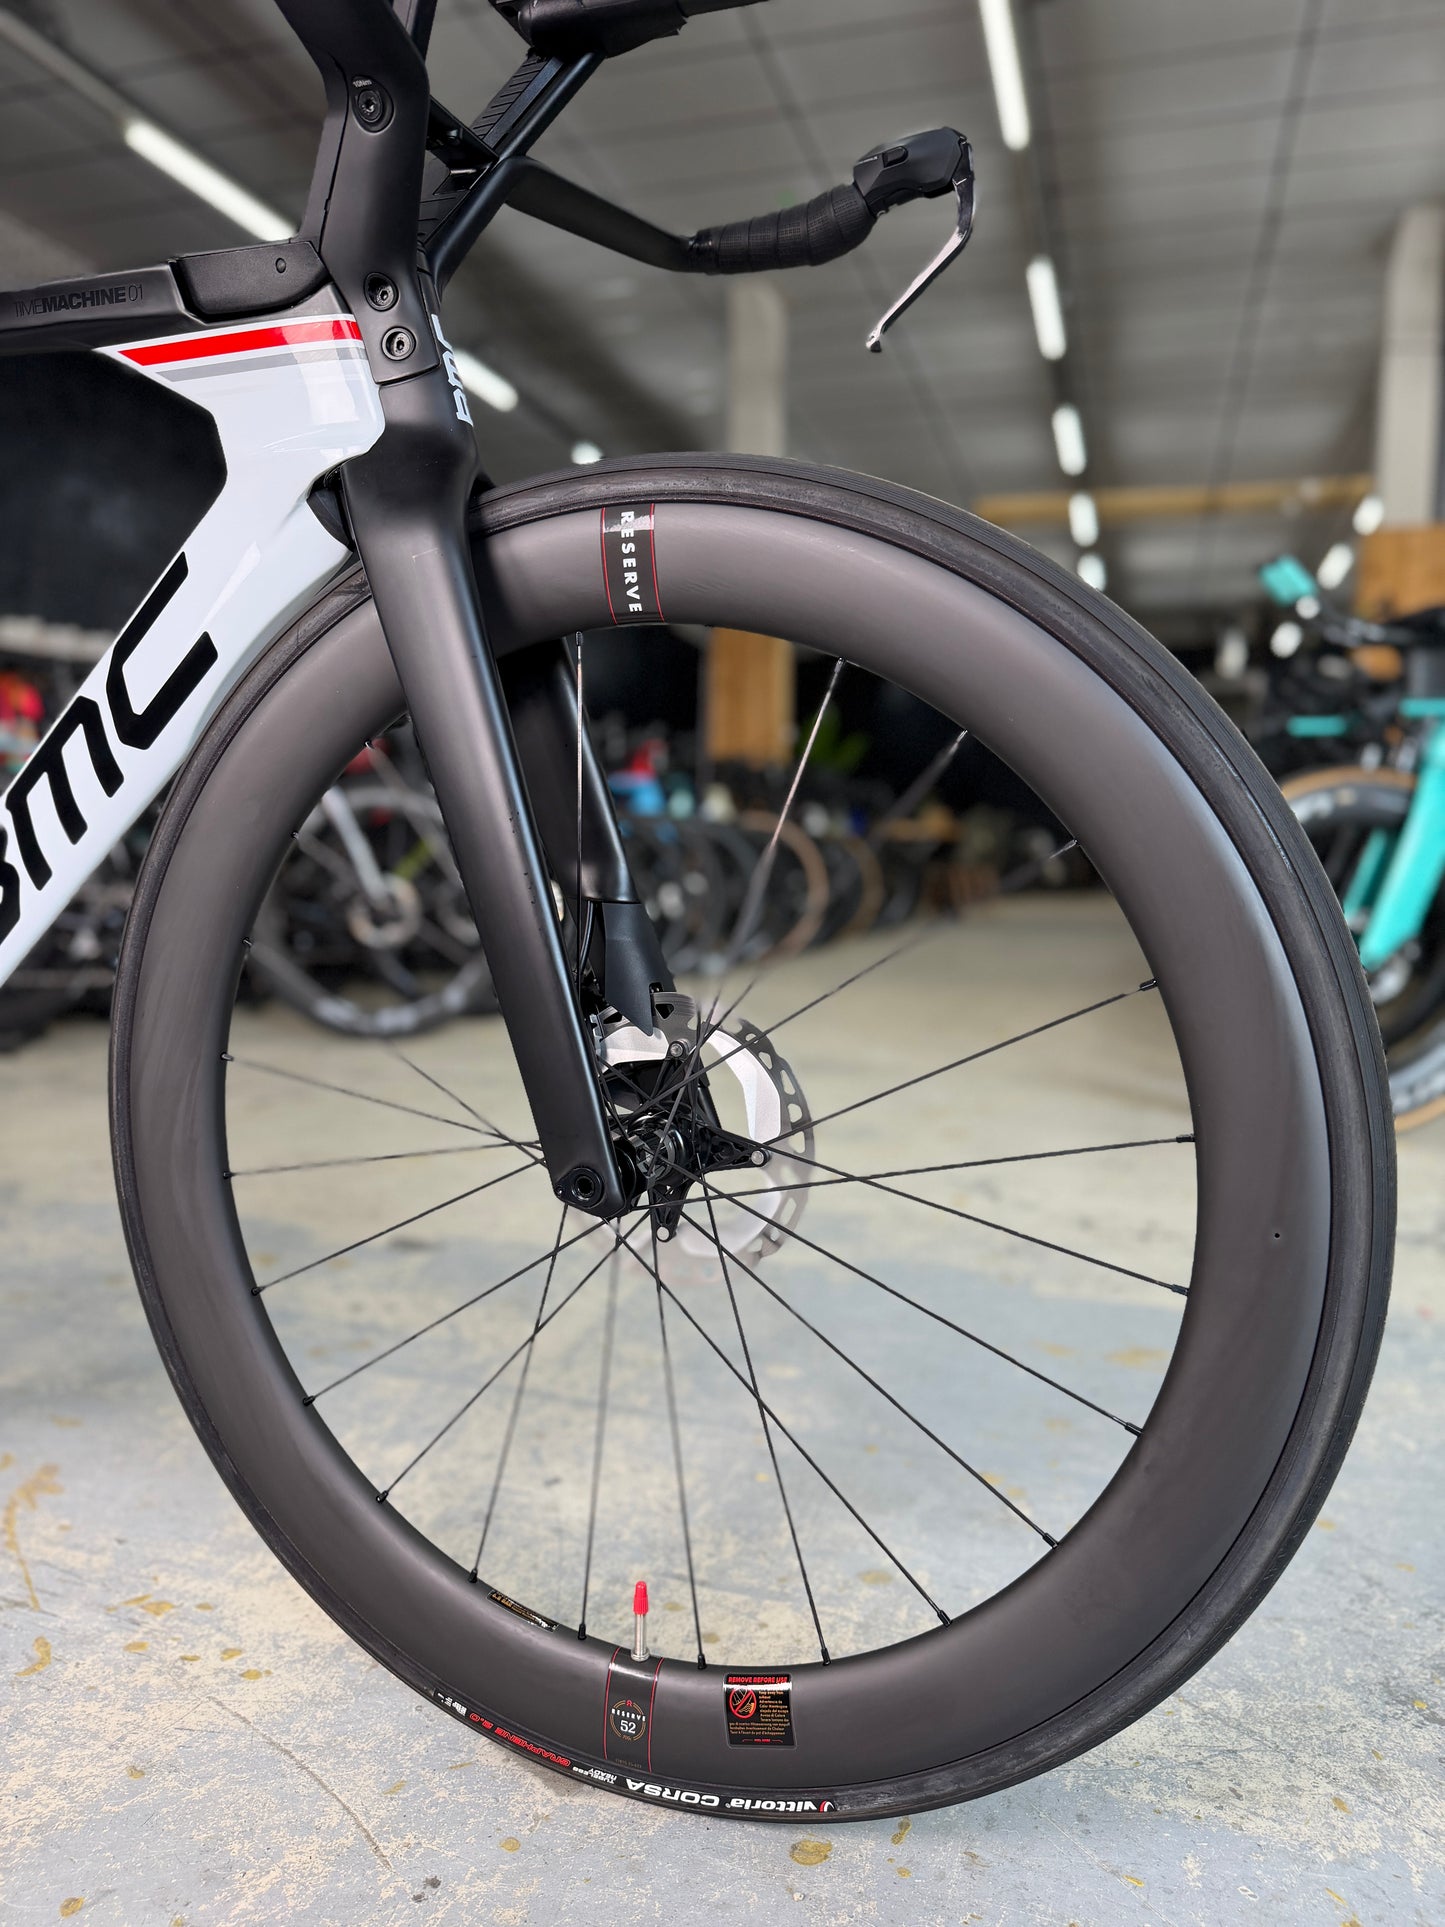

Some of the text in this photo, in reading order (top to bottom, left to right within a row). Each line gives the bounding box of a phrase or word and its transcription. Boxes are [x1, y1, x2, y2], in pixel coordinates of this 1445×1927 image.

[620, 510, 643, 612] RESERVE
[611, 1708, 646, 1722] RESERVE
[620, 1719, 637, 1734] 52
[469, 1713, 571, 1767] GRAPHENE 2.0
[588, 1768, 617, 1781] READY
[626, 1778, 720, 1807] CORSA
